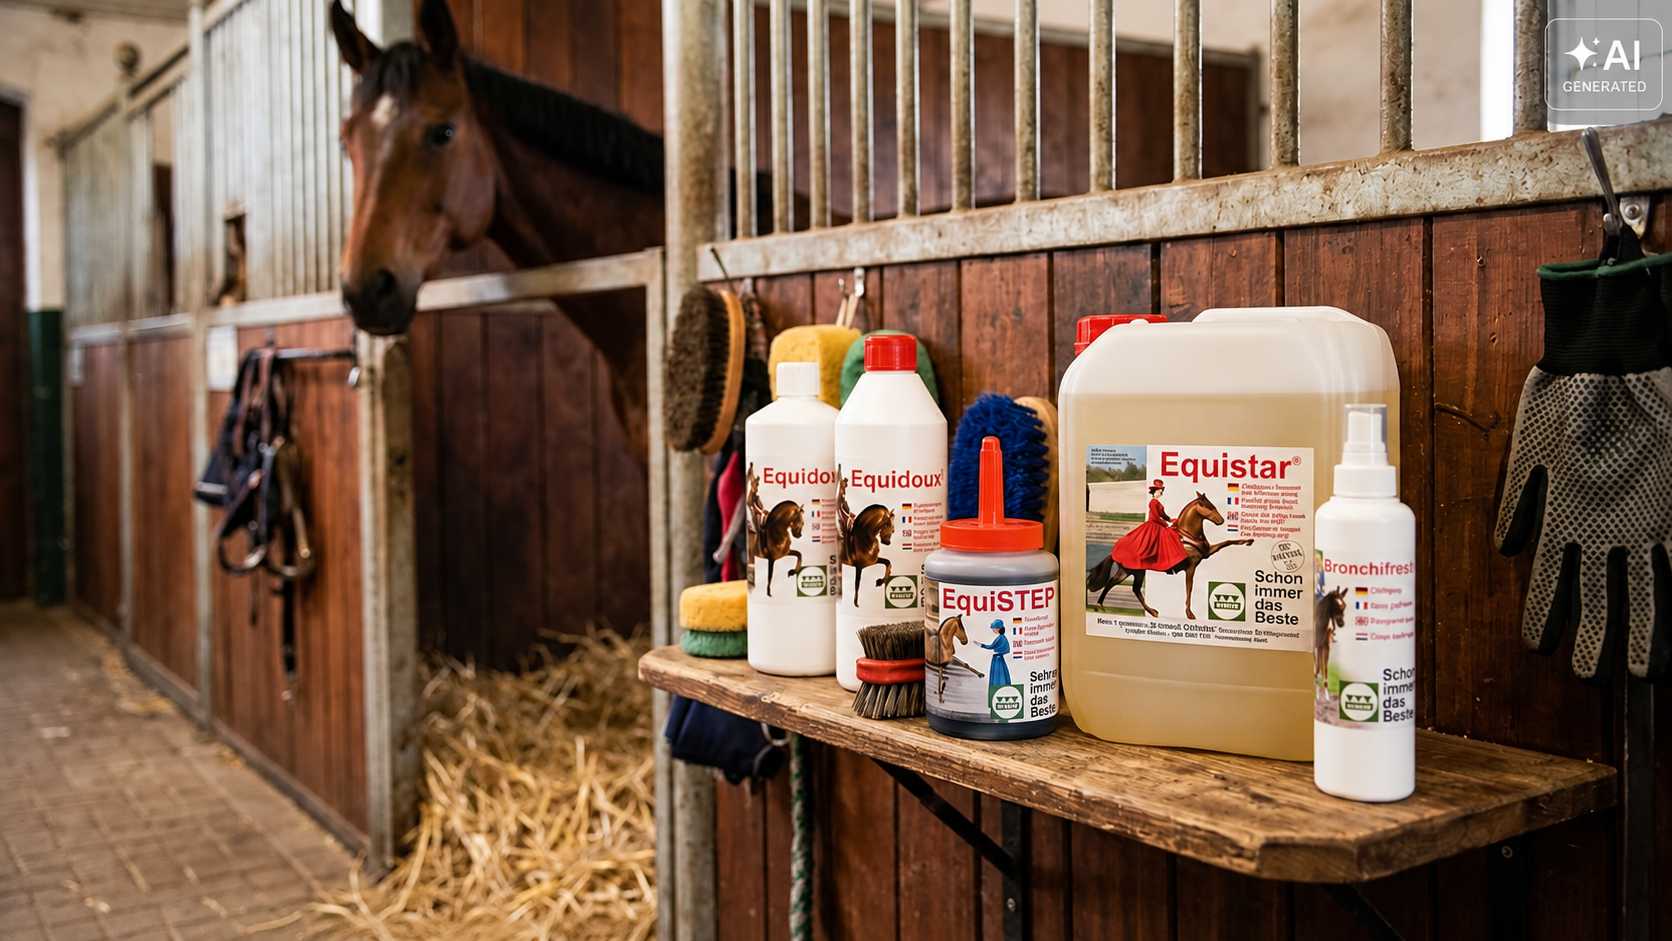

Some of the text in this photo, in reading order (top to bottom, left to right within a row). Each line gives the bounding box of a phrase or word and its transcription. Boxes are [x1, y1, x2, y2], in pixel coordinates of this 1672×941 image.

[1255, 570, 1303, 585] Schon
[1255, 585, 1303, 599] immer
[943, 586, 1056, 616] EquiSTEP
[1255, 599, 1283, 612] das
[1255, 612, 1299, 625] Beste
[1383, 682, 1414, 695] imme
[1030, 695, 1048, 706] das
[1383, 696, 1406, 709] das
[1030, 704, 1056, 718] Beste
[1383, 709, 1414, 722] Beste
